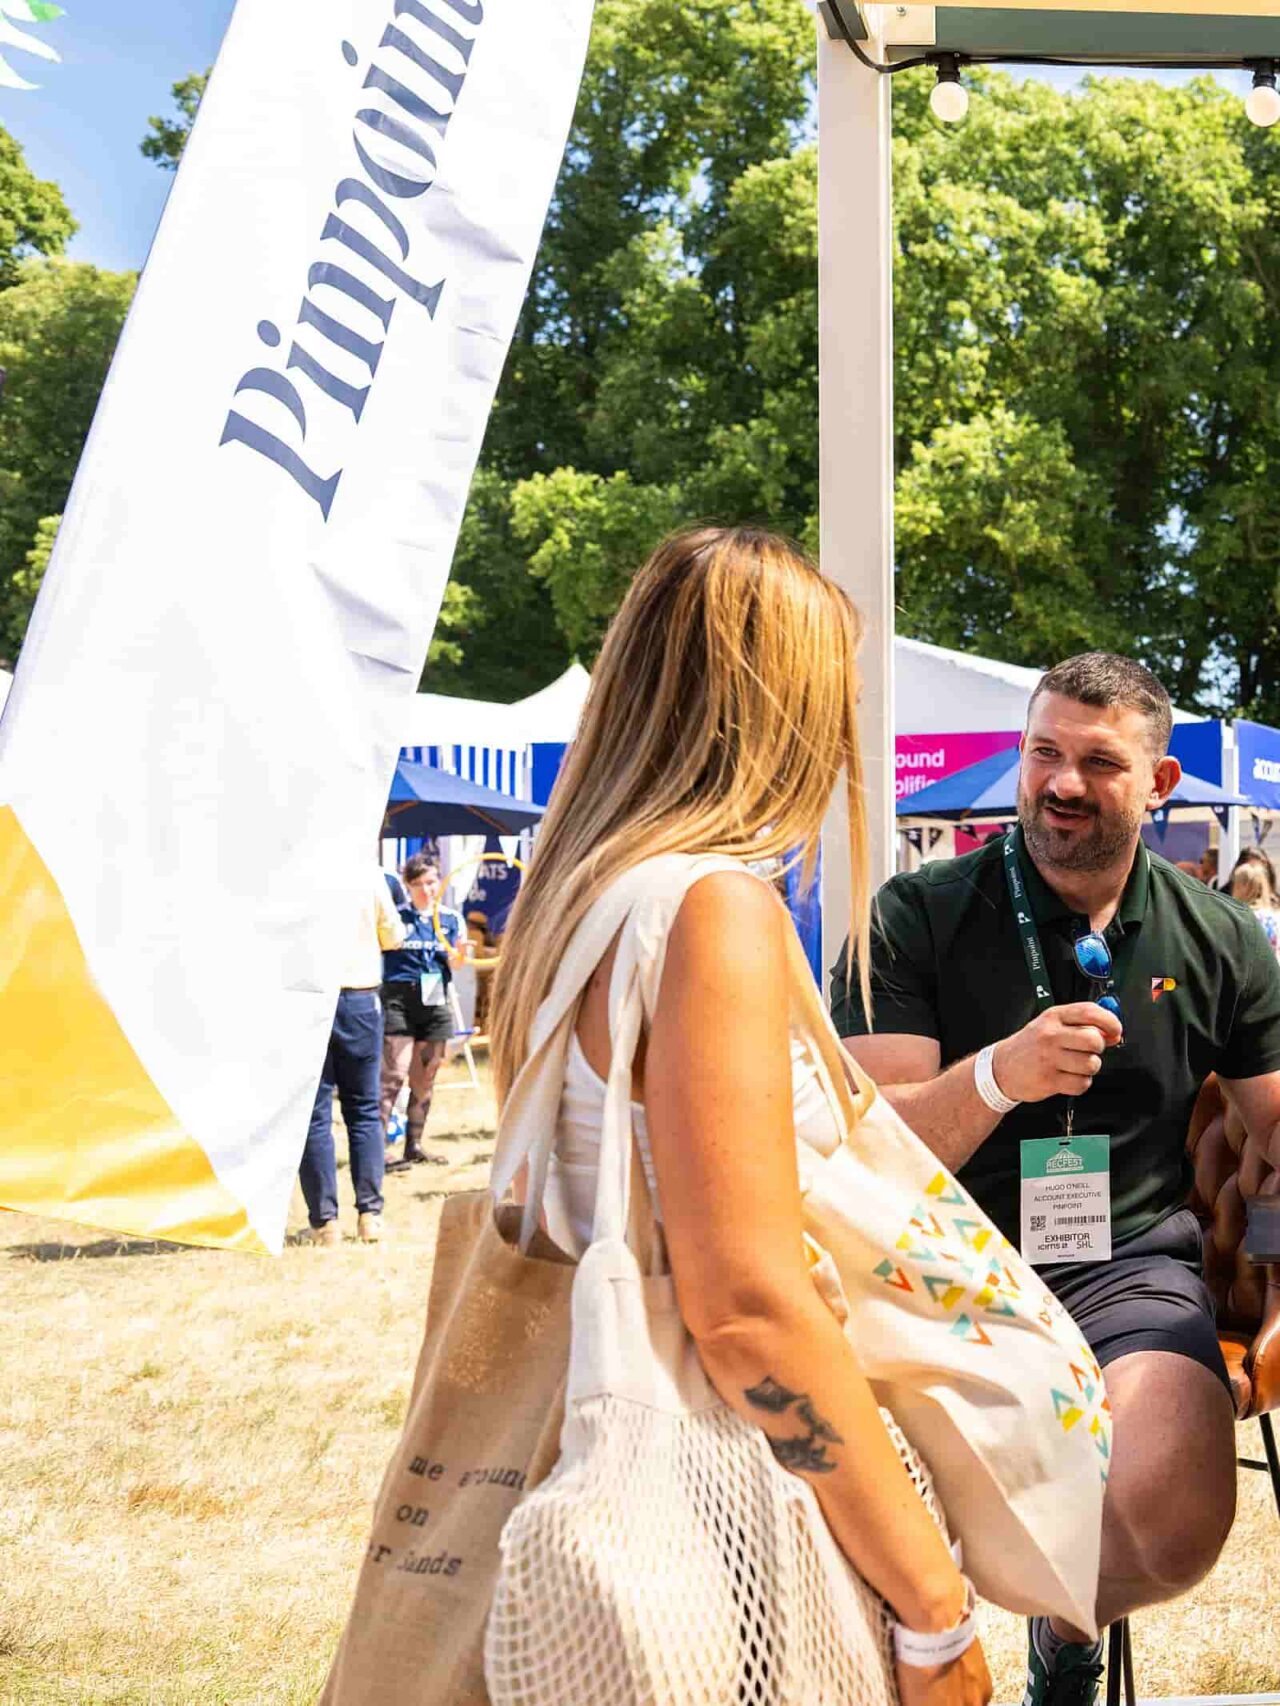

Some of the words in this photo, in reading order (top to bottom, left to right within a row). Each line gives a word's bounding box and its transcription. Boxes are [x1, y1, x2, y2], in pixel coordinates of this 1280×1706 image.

[1026, 936, 1041, 970] Pinpoint
[1034, 1193, 1065, 1202] ACCOUNT
[1066, 1191, 1102, 1200] EXECUTIVE
[1052, 1202, 1083, 1210] PINPOINT
[1044, 1232, 1090, 1243] EXHIBITOR
[1076, 1240, 1094, 1250] SHL
[408, 1455, 444, 1481] me
[396, 1504, 429, 1527] on
